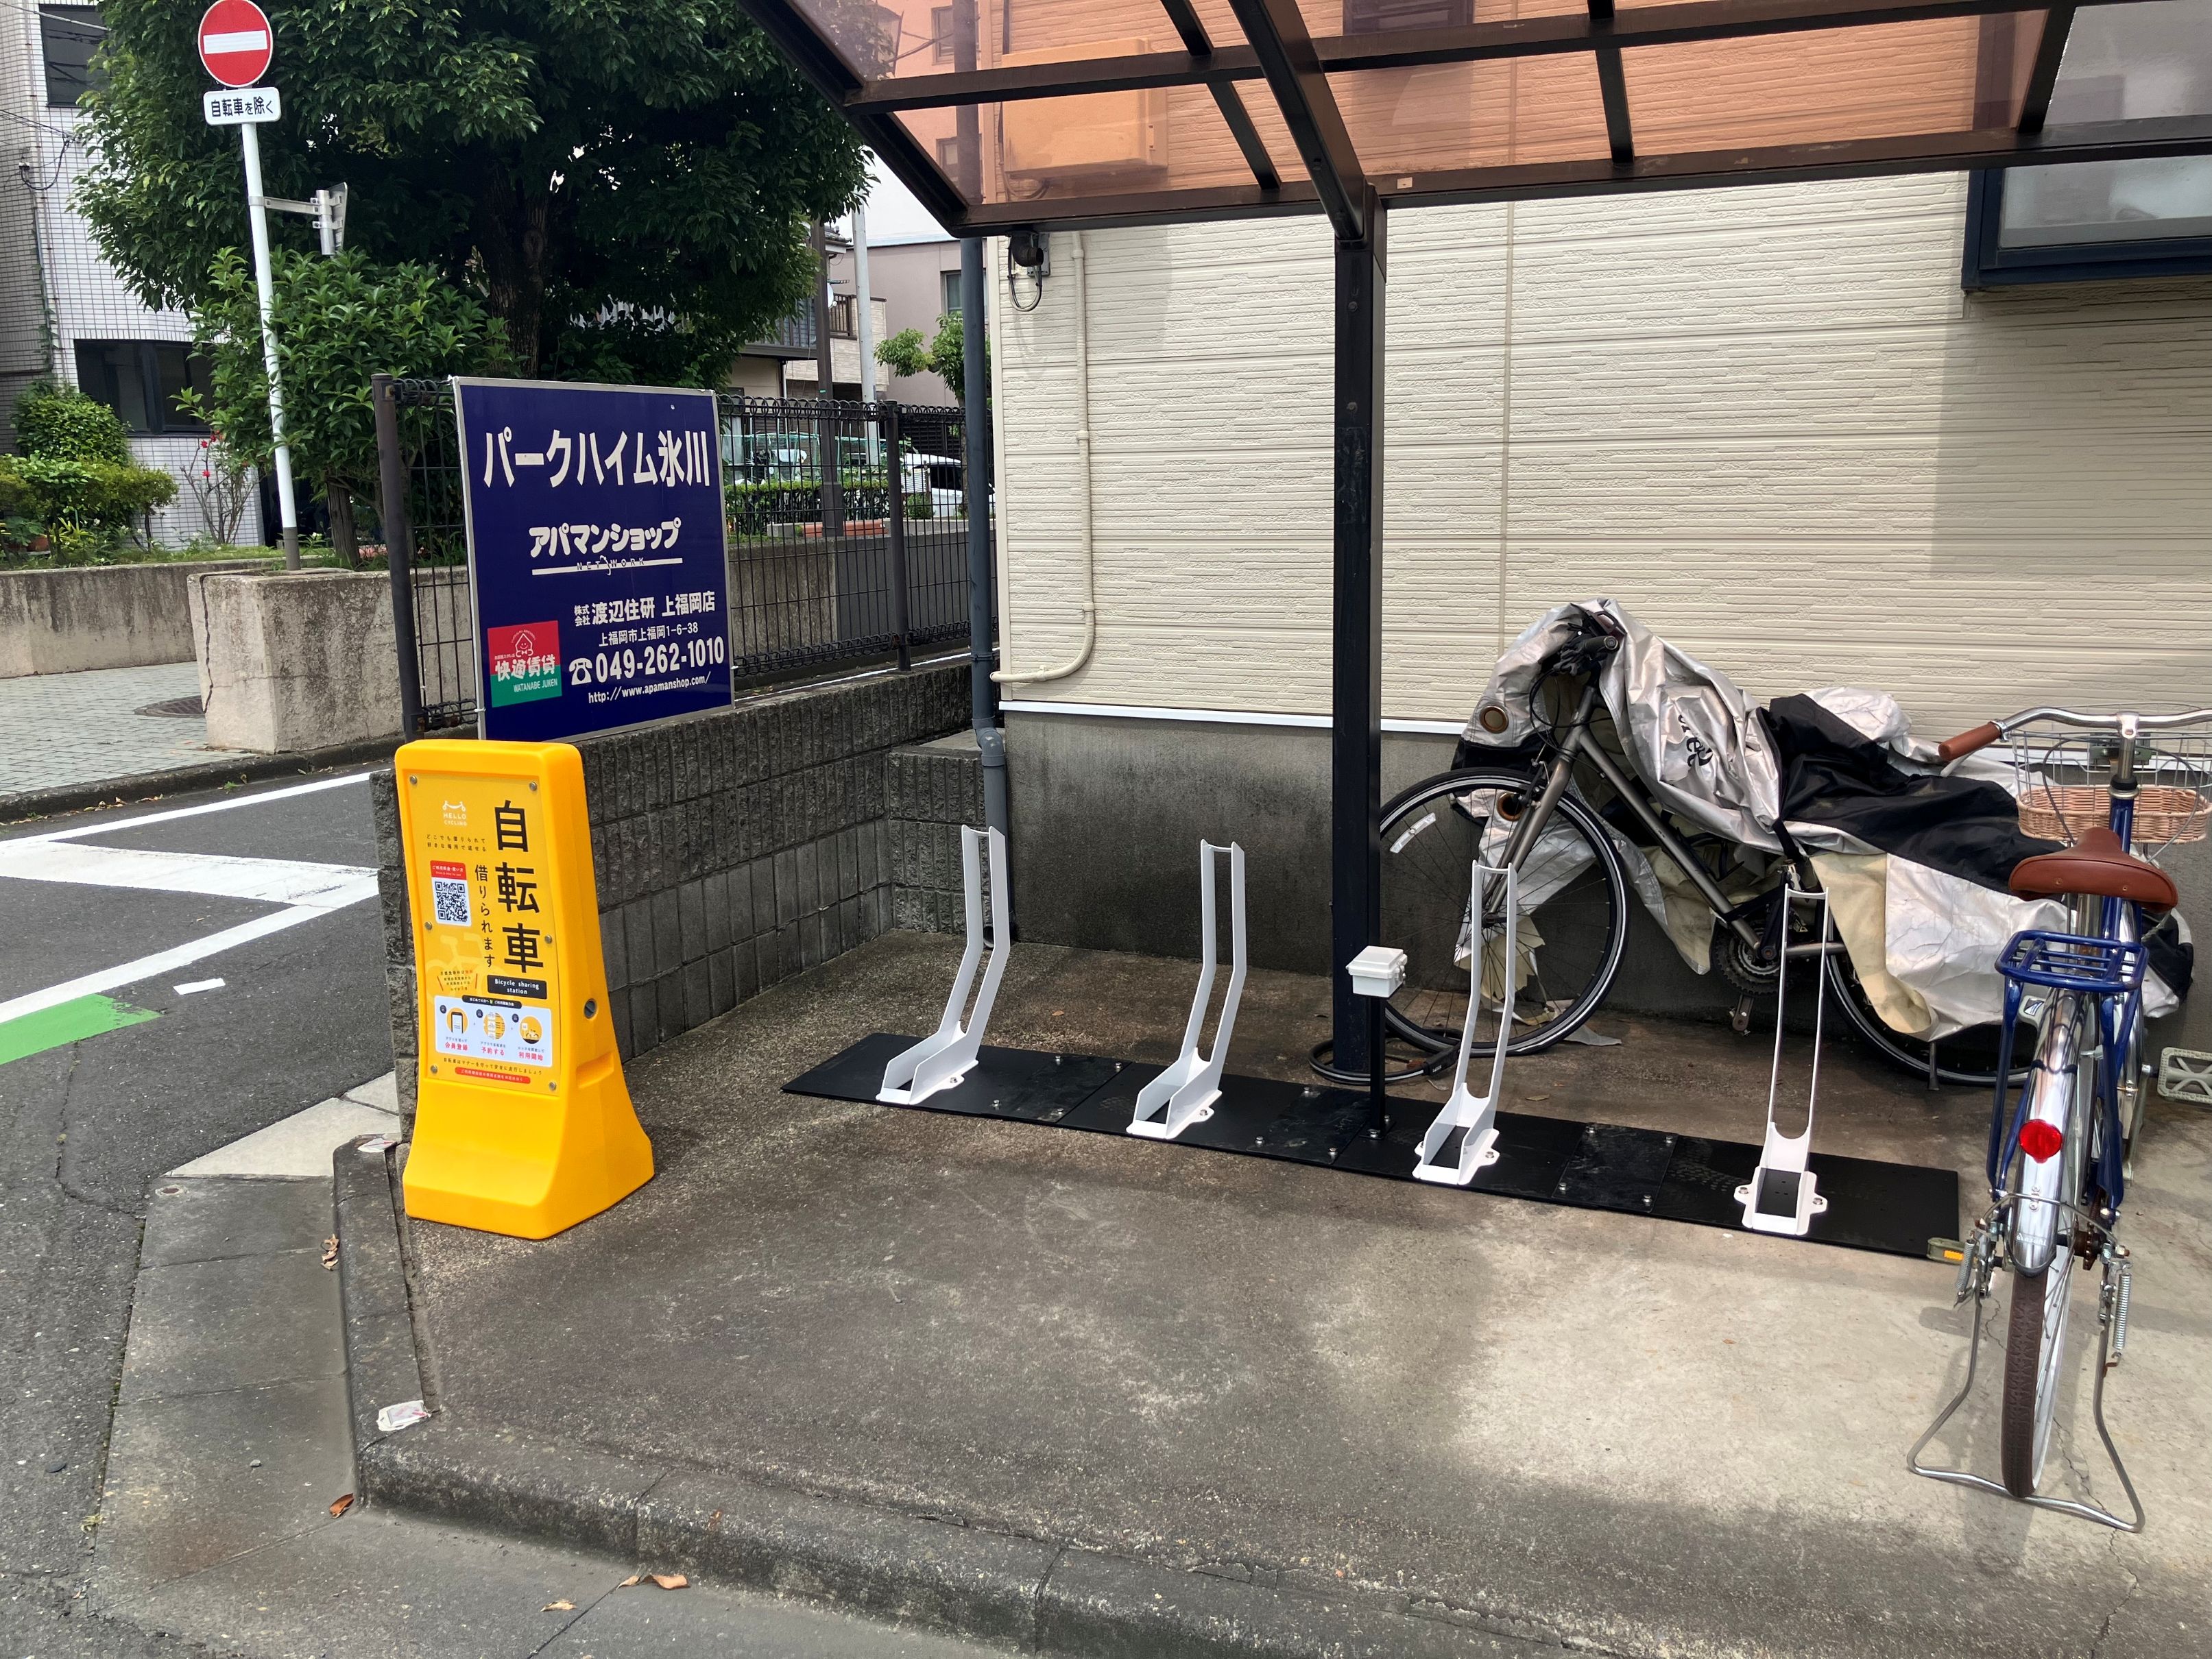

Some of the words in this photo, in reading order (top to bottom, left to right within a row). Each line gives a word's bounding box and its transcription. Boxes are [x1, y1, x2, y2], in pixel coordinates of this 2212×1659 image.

[211, 96, 274, 117] 自転車を除く
[483, 426, 710, 487] パークハイム氷川
[529, 517, 682, 558] アパマンショップ
[662, 591, 716, 616] 上福岡店
[599, 622, 699, 647] 上福岡市上福岡1-6-38
[495, 654, 555, 682] 快適賃貸
[595, 636, 725, 683] 049-262-1010
[514, 681, 540, 692] WATANABE
[542, 678, 558, 688] JUKEN
[588, 670, 712, 703] http://www.apamanshop.com/
[494, 799, 543, 973] 自転車
[475, 864, 495, 967] 借りられます
[494, 978, 516, 986] Bicycle
[518, 982, 540, 991] sharing
[481, 1046, 505, 1056] 予約する
